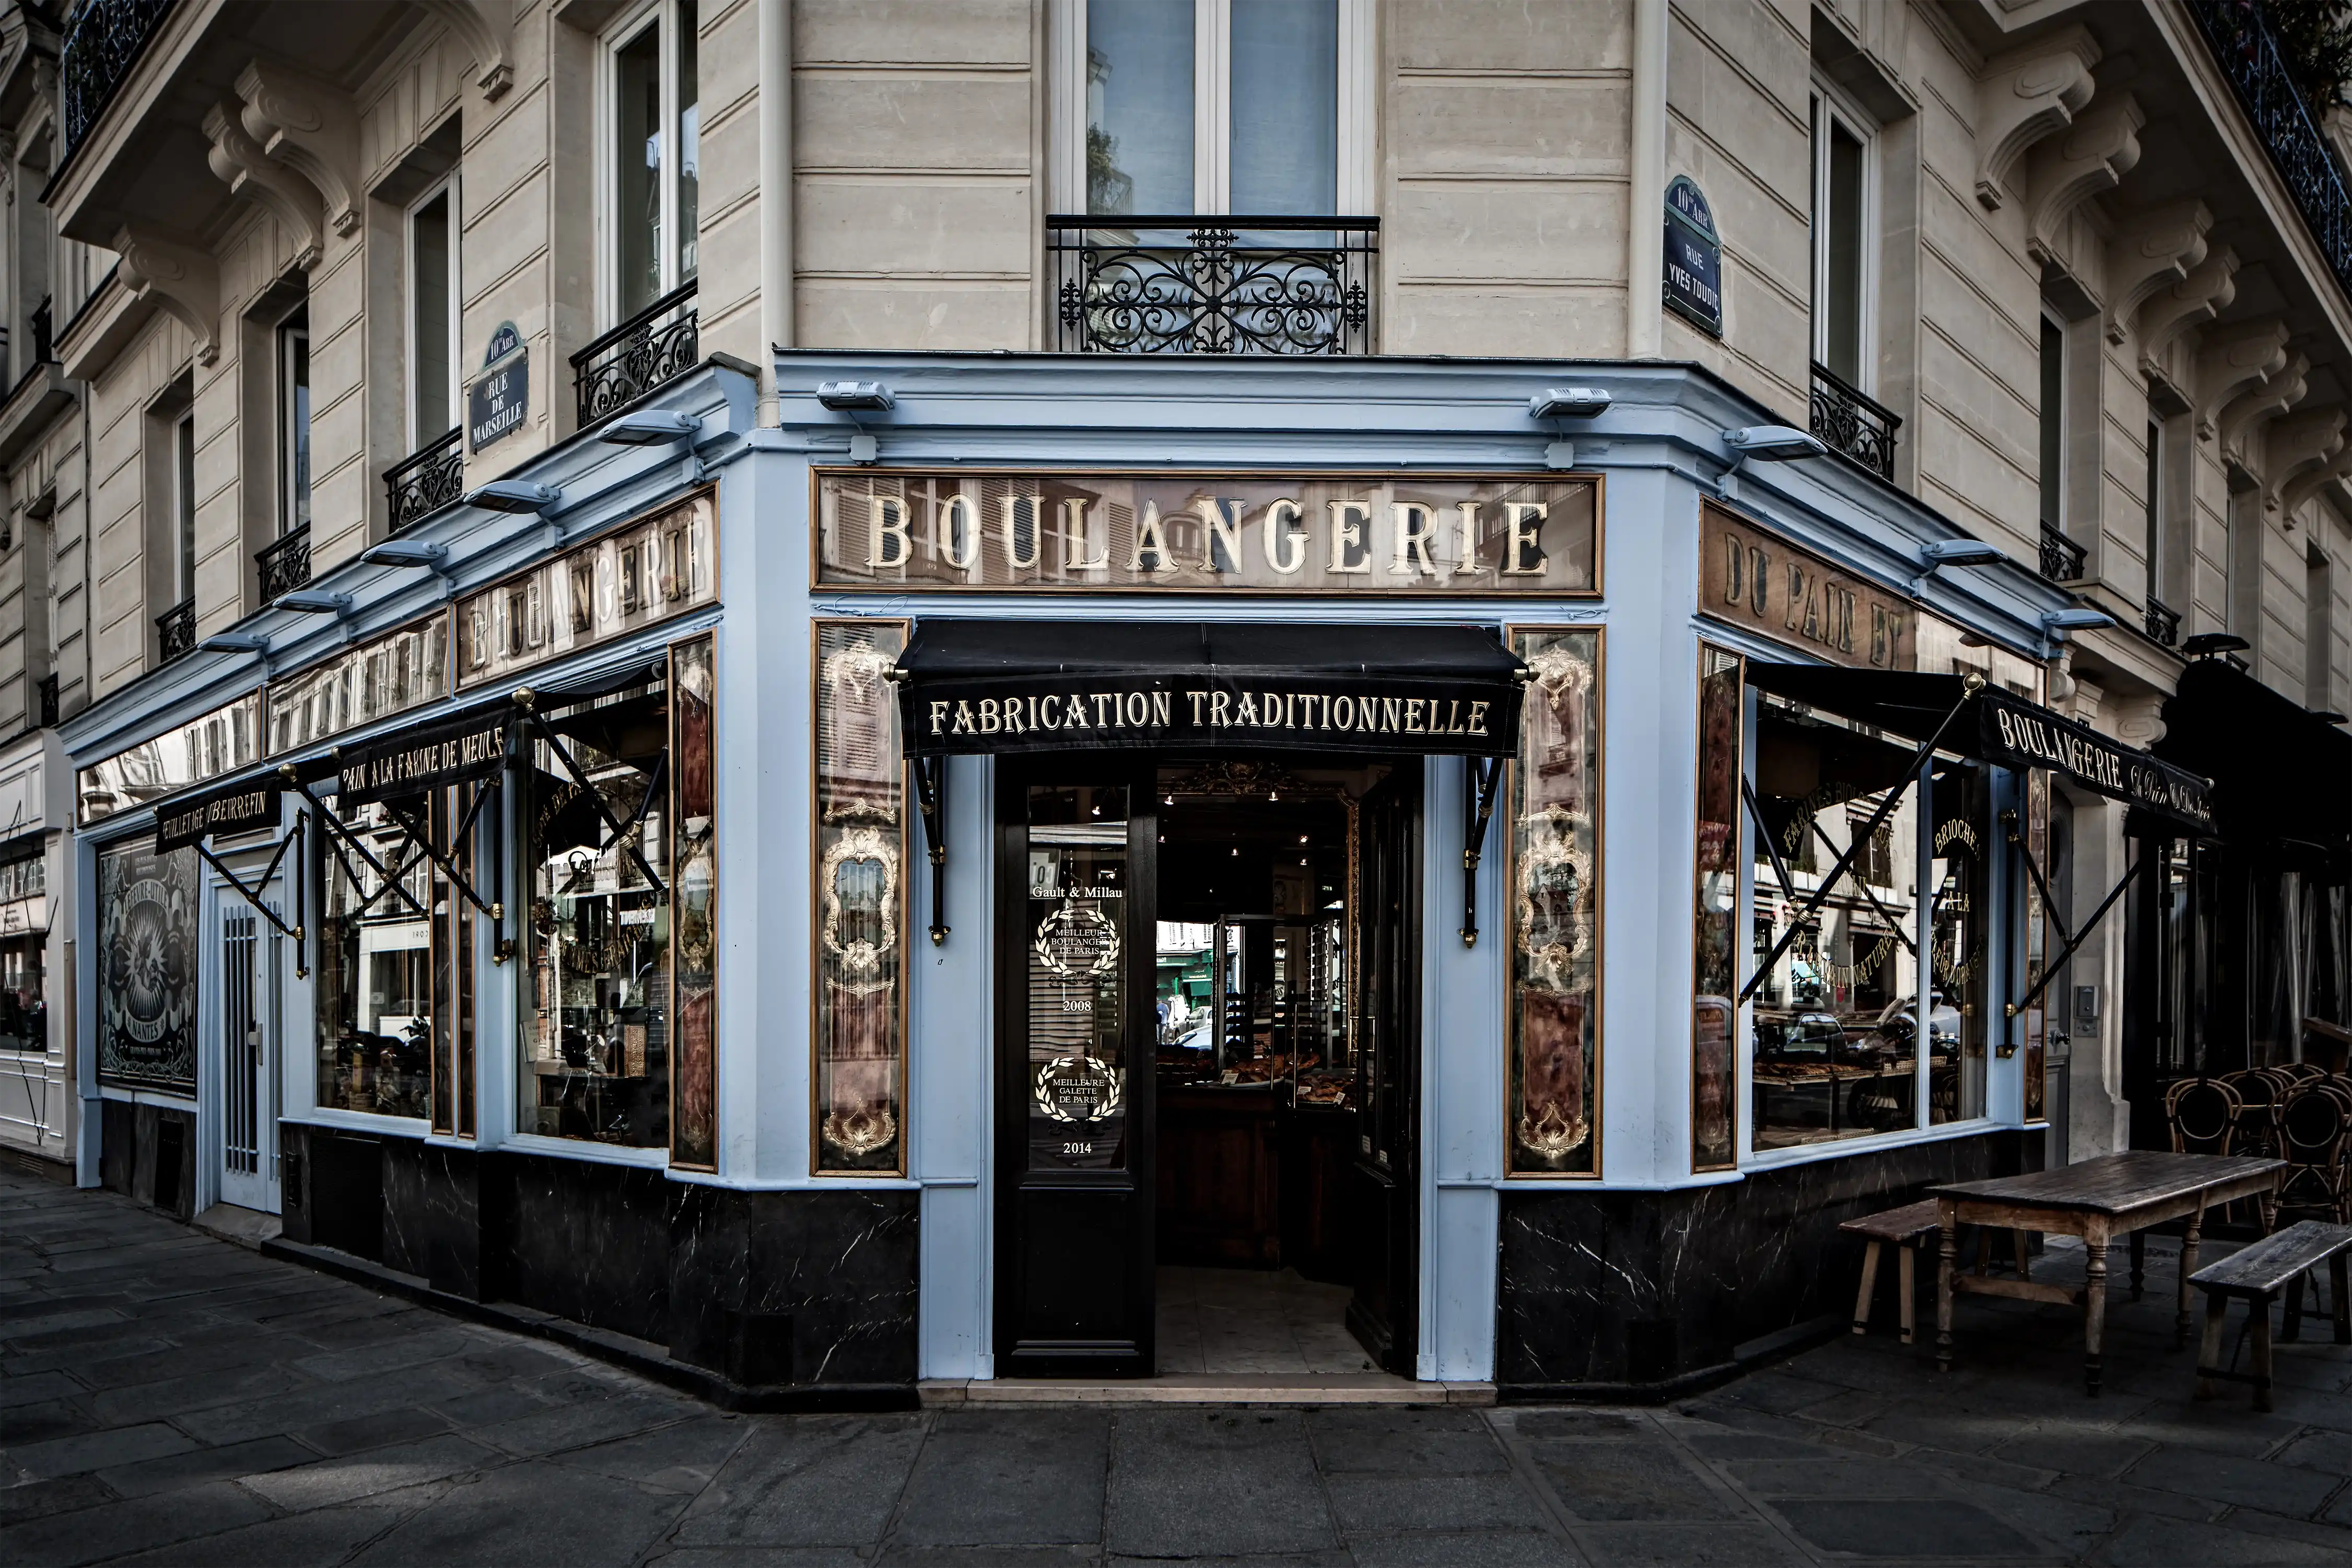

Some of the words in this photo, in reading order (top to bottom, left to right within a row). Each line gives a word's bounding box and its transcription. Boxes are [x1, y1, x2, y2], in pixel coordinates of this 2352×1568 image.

[1686, 243, 1704, 271] RUE
[1669, 262, 1690, 291] YVES
[1692, 277, 1718, 312] TOUDIC
[488, 371, 508, 400] RUE
[492, 394, 504, 415] DE
[473, 401, 522, 446] MARSEILLE
[865, 494, 1550, 577] BOULANGERIE
[1725, 532, 1771, 617] DU
[1785, 563, 1857, 654] PAIN
[1871, 602, 1903, 671] ET
[930, 692, 1172, 735] FABRICATION
[1187, 691, 1490, 736] TRADITIONNELLE
[343, 763, 366, 793] PAIN
[380, 756, 394, 785] LA
[397, 744, 439, 781] FARINE
[442, 740, 458, 771] DE
[1997, 708, 2124, 791] BOULANGERIE
[1783, 782, 1832, 854] FARINES
[1935, 818, 1982, 861] BRIOCHES
[1032, 886, 1066, 898] Gault
[1069, 886, 1080, 898] &
[1084, 886, 1123, 898] Millau
[1957, 892, 1970, 912] LA
[1849, 919, 1898, 987] NATUREL
[1063, 1000, 1092, 1012] 2008
[132, 1022, 158, 1041] NANTES
[1052, 1079, 1105, 1087] MEILLEURE
[1059, 1095, 1071, 1104] DE
[1073, 1095, 1098, 1104] PARIS
[1063, 1142, 1092, 1154] 2014
